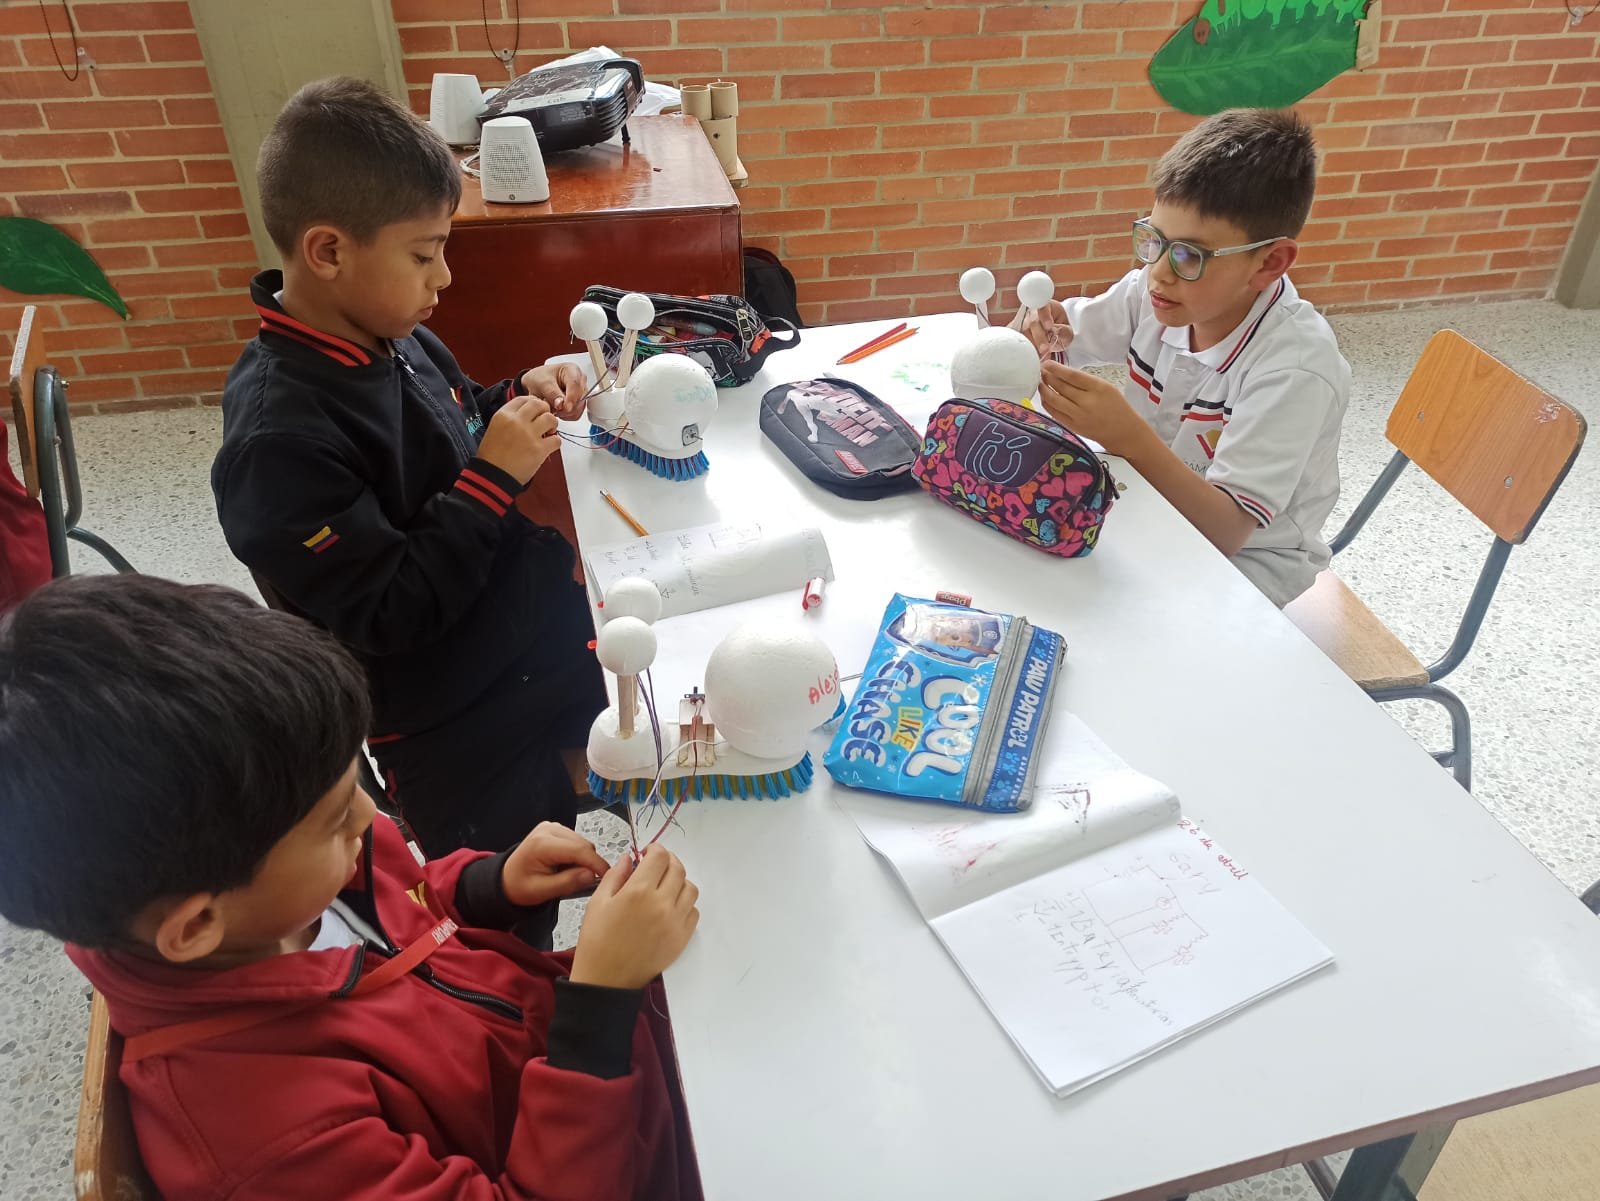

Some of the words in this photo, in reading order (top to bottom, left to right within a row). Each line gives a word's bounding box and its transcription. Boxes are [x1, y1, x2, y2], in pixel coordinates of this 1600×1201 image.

[1020, 656, 1048, 695] PAW
[840, 659, 922, 768] CHASE
[892, 705, 924, 753] LIKE
[903, 675, 981, 778] COOL
[1007, 693, 1038, 749] PATROL
